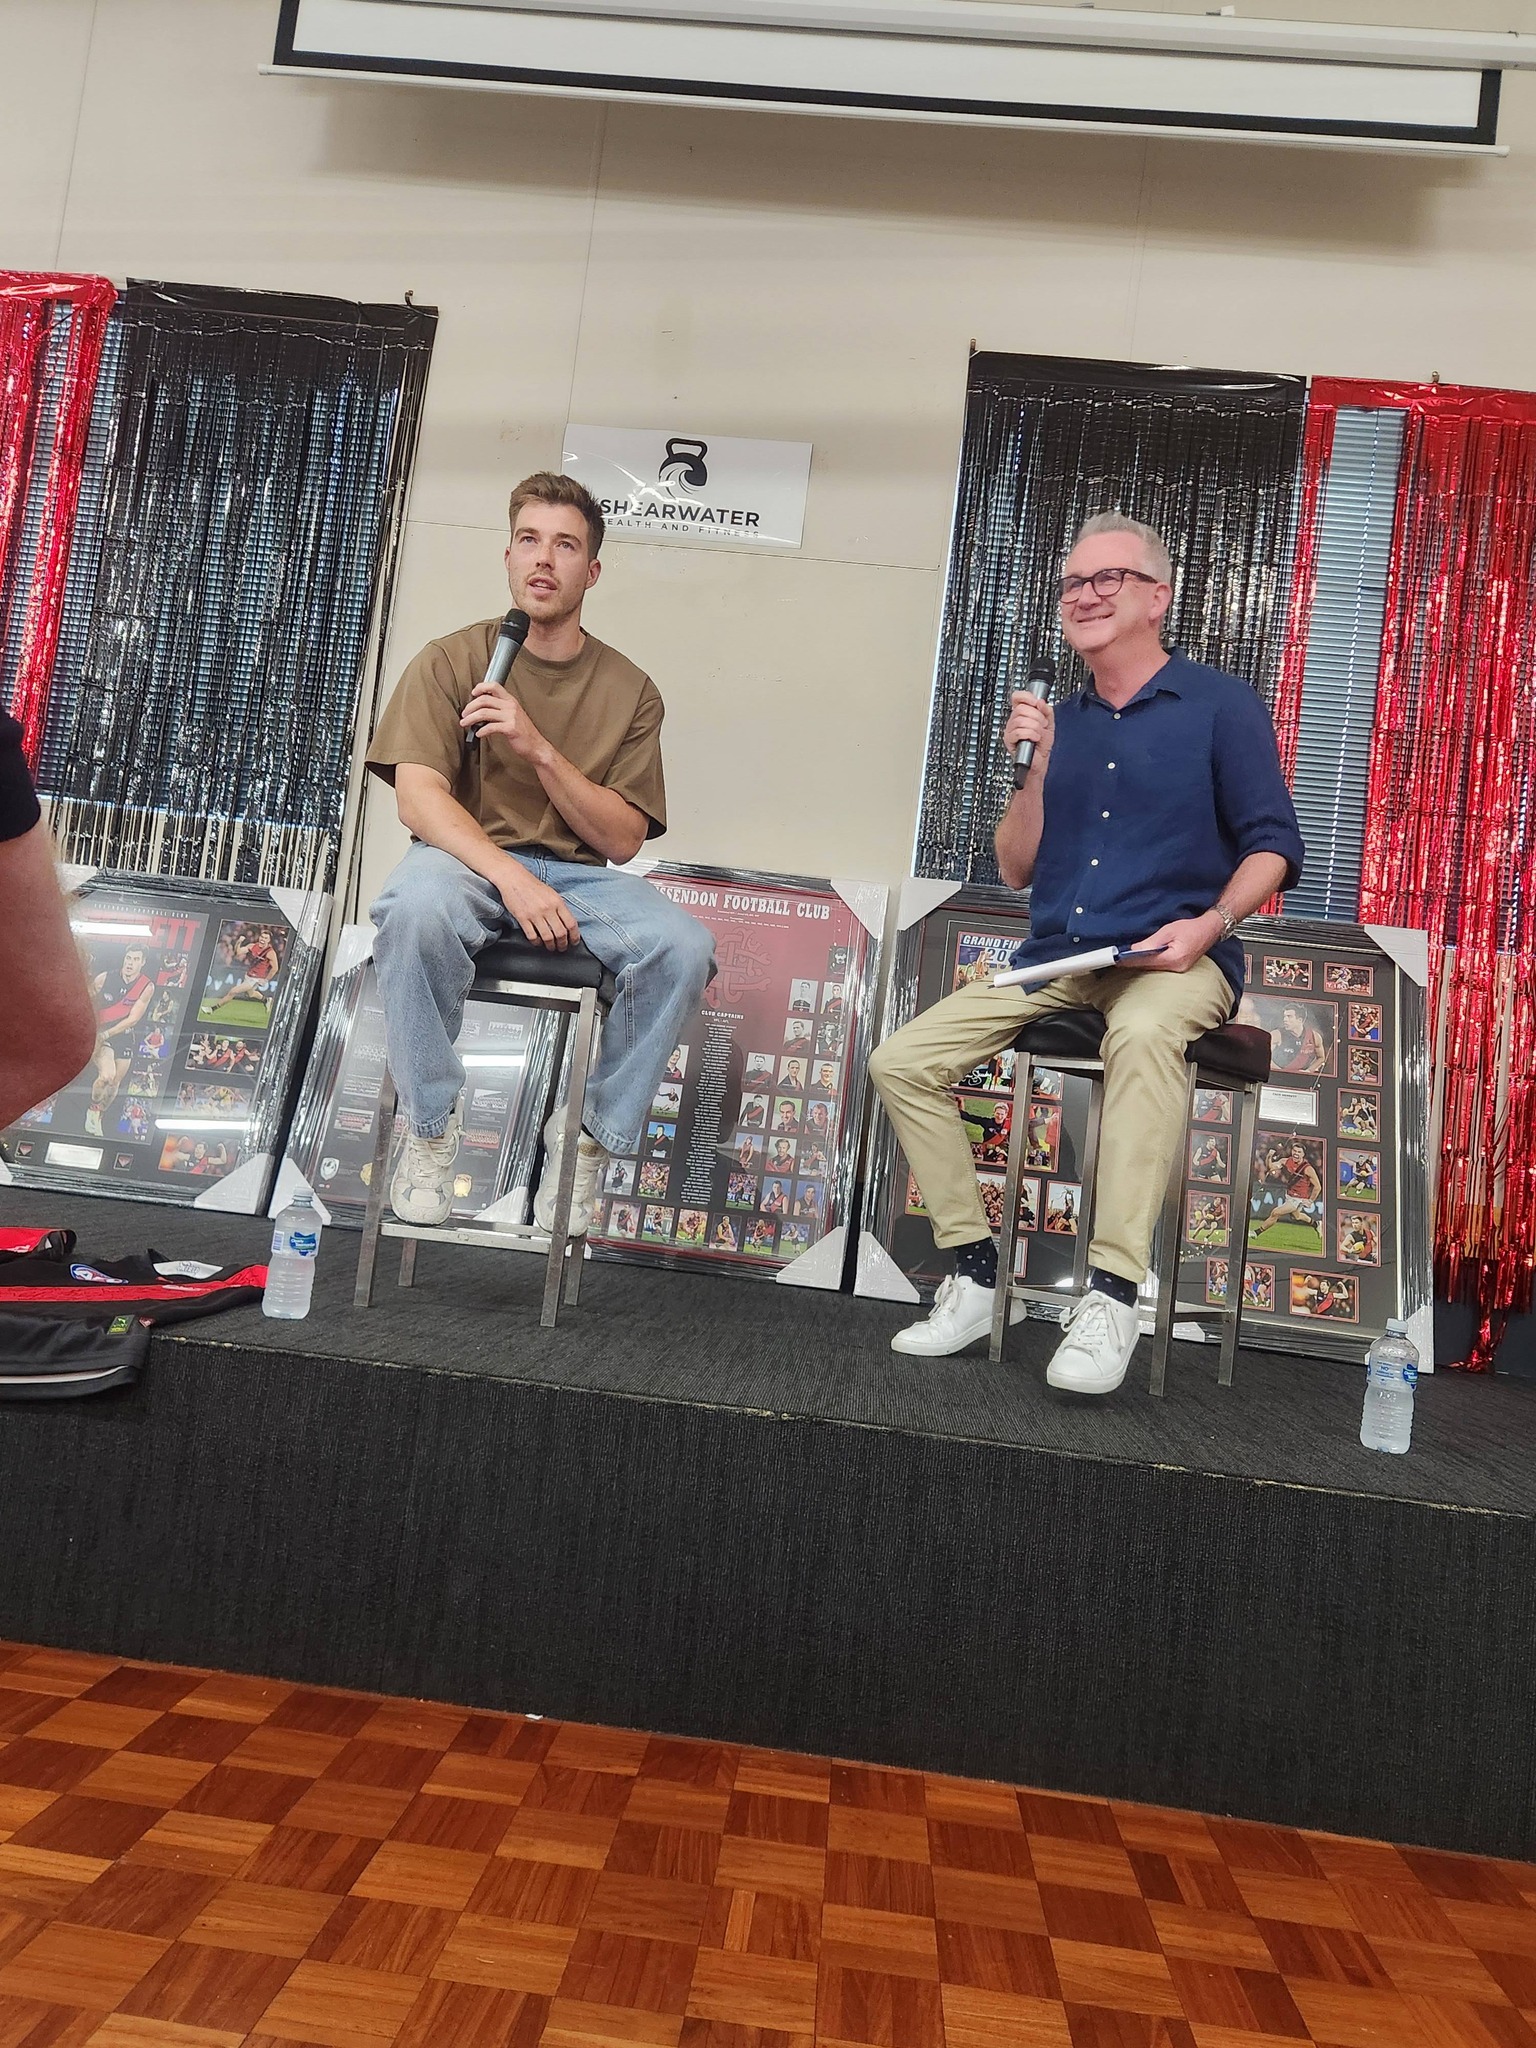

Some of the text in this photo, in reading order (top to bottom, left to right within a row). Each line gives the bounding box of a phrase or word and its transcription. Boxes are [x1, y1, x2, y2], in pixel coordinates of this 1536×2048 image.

[600, 499, 760, 527] SHEARWATER
[605, 518, 760, 538] EALTH AND FITNESS
[655, 886, 831, 920] SENDON FOOTBALL CLUB
[962, 935, 1022, 950] GRAND FIN
[716, 1012, 744, 1020] CAPTAINS
